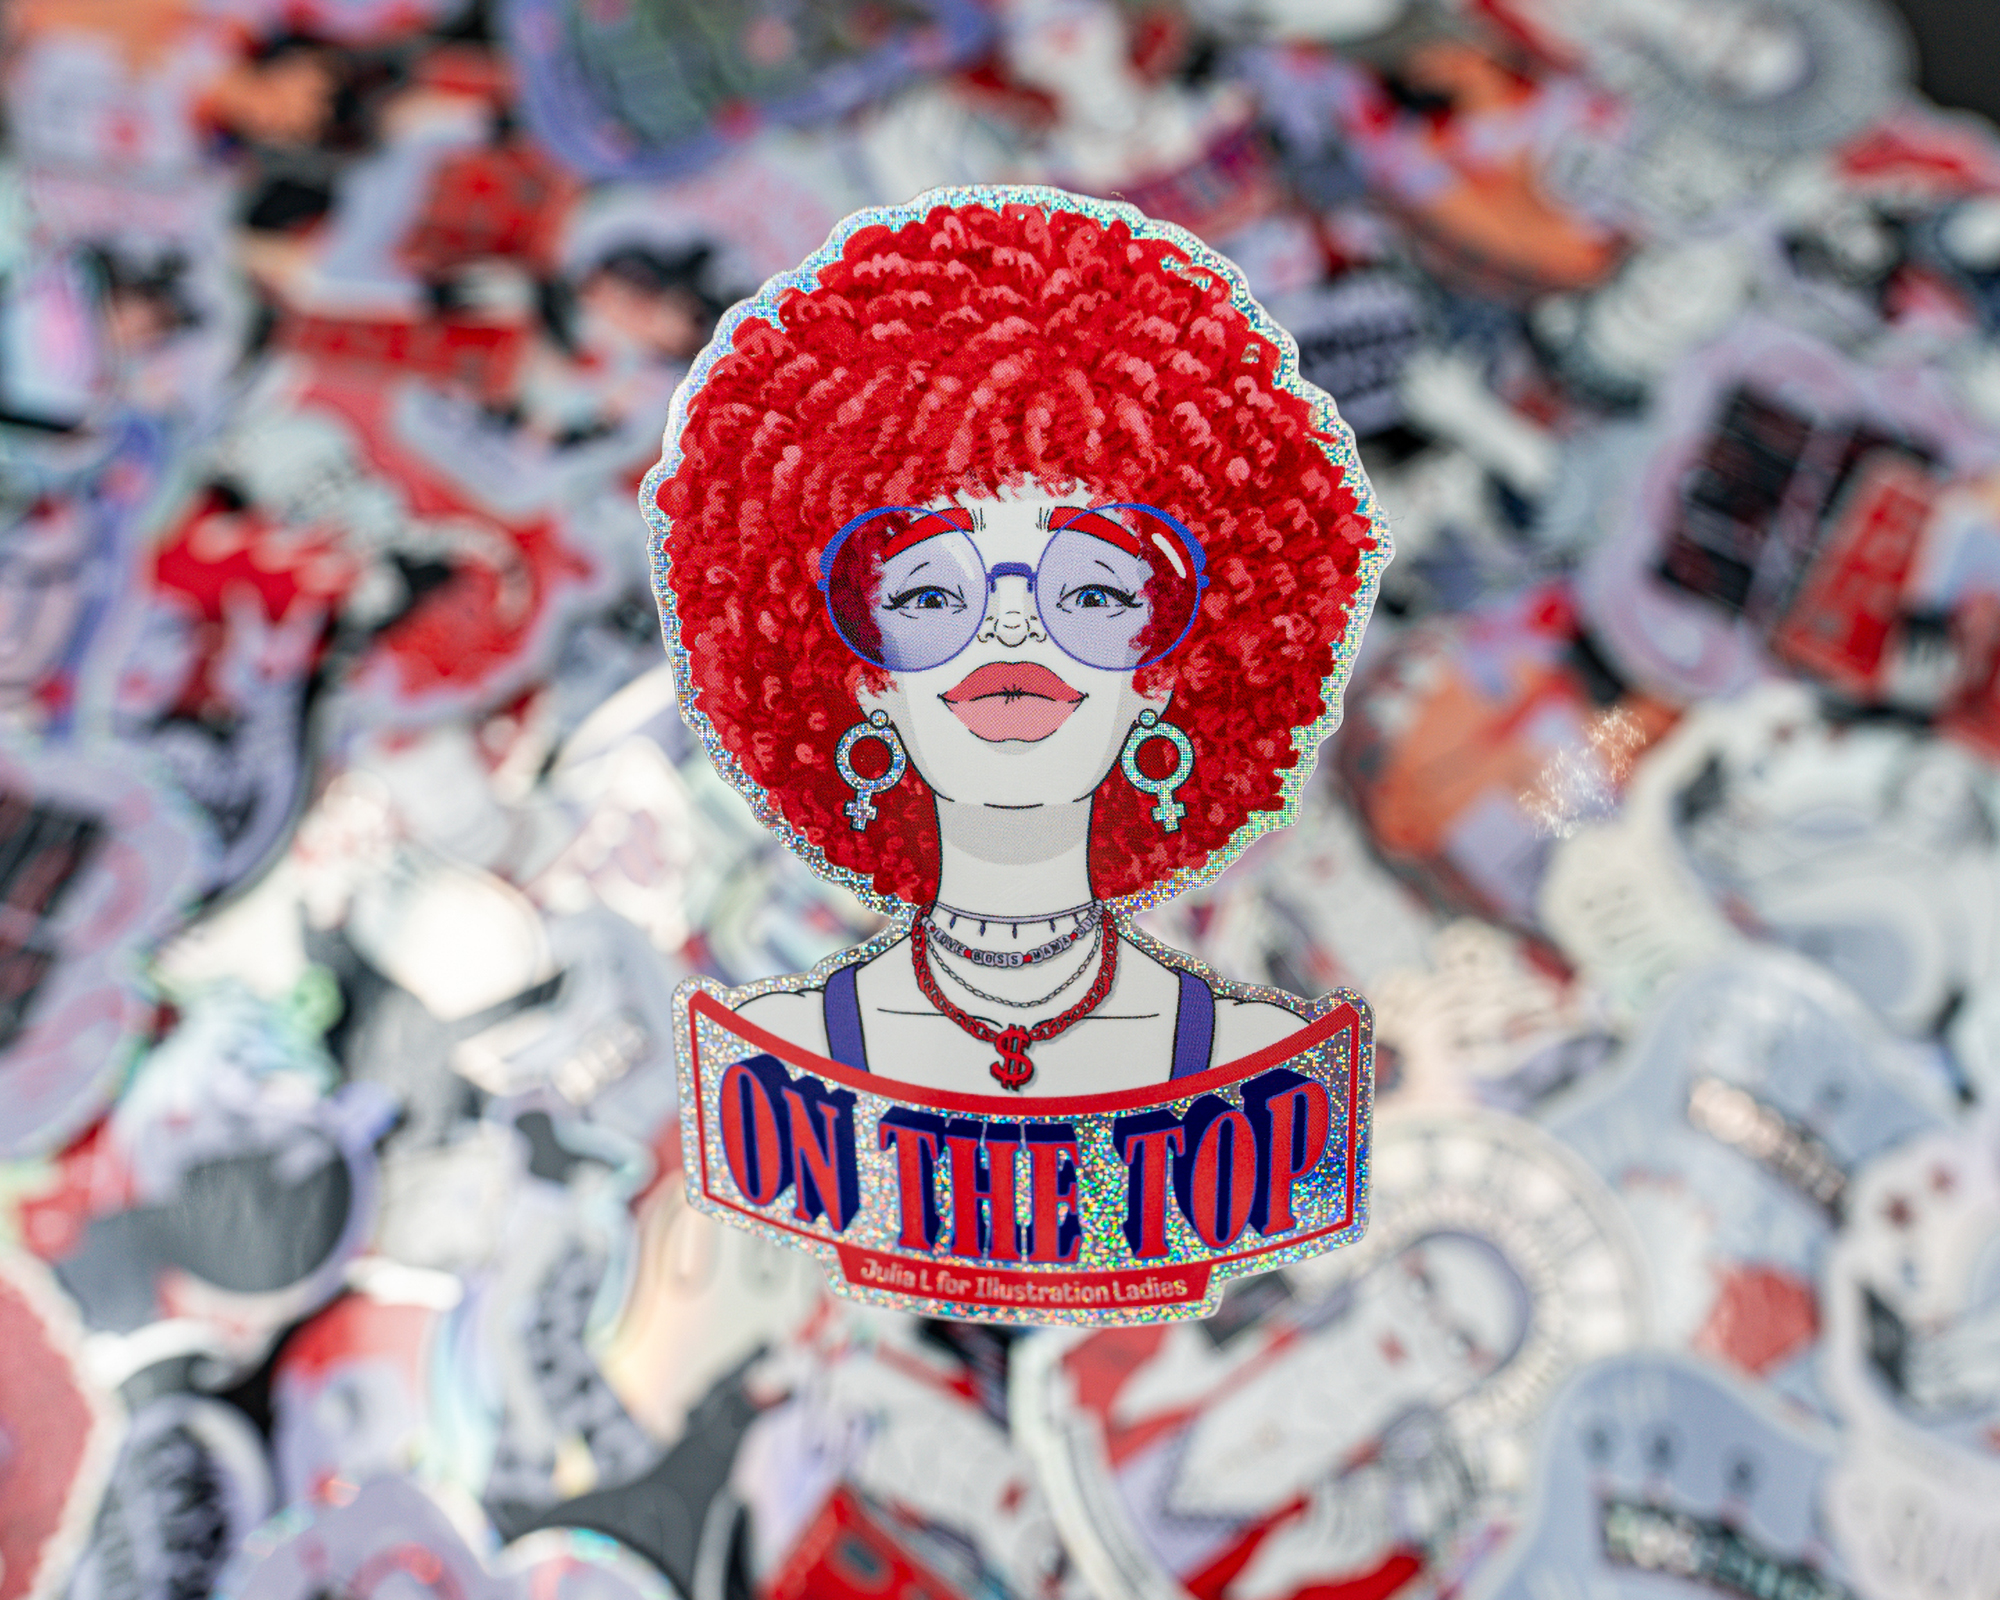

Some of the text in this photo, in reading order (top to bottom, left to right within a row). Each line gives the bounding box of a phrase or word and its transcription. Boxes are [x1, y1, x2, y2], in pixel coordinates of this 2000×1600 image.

[971, 950, 1022, 966] BOSS
[1030, 936, 1071, 962] MAMA
[719, 1053, 1331, 1265] ON THE TOP
[860, 1257, 1188, 1304] Julia L for Illustration Ladies
